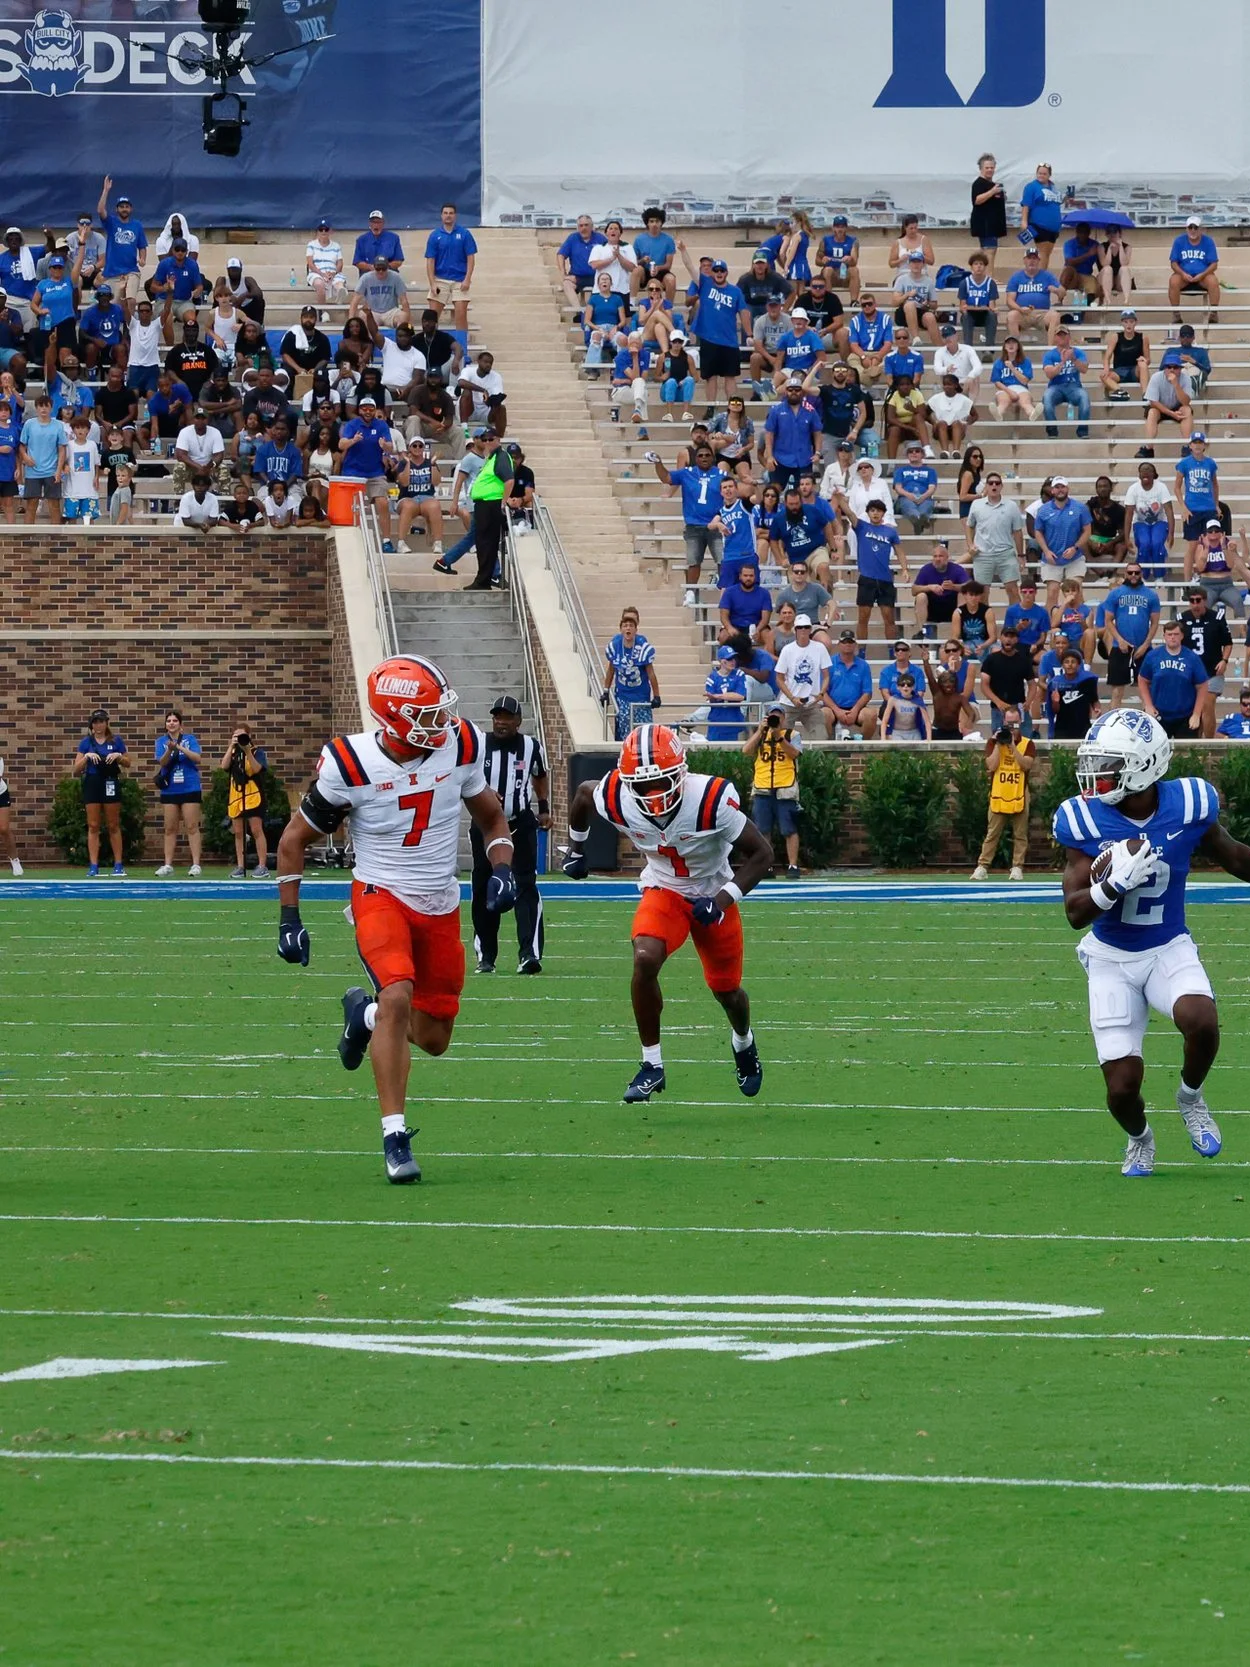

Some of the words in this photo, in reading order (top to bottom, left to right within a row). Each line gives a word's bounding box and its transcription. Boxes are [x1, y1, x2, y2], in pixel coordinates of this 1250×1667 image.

[36, 29, 53, 39] BULL
[54, 29, 71, 39] CITY
[1181, 250, 1206, 260] DUKE
[1018, 282, 1043, 293] DUKE
[707, 288, 734, 309] DUKE
[786, 344, 812, 356] DUKE
[1189, 469, 1211, 480] DUKE
[722, 511, 743, 526] DUKE
[1118, 596, 1149, 607] DUKE
[1191, 634, 1204, 655] 3
[1160, 659, 1186, 672] DUKE
[375, 676, 420, 698] ILLINOIS
[999, 772, 1020, 785] 045
[398, 789, 434, 847] 7
[657, 844, 690, 877] 1
[1120, 862, 1171, 926] 2
